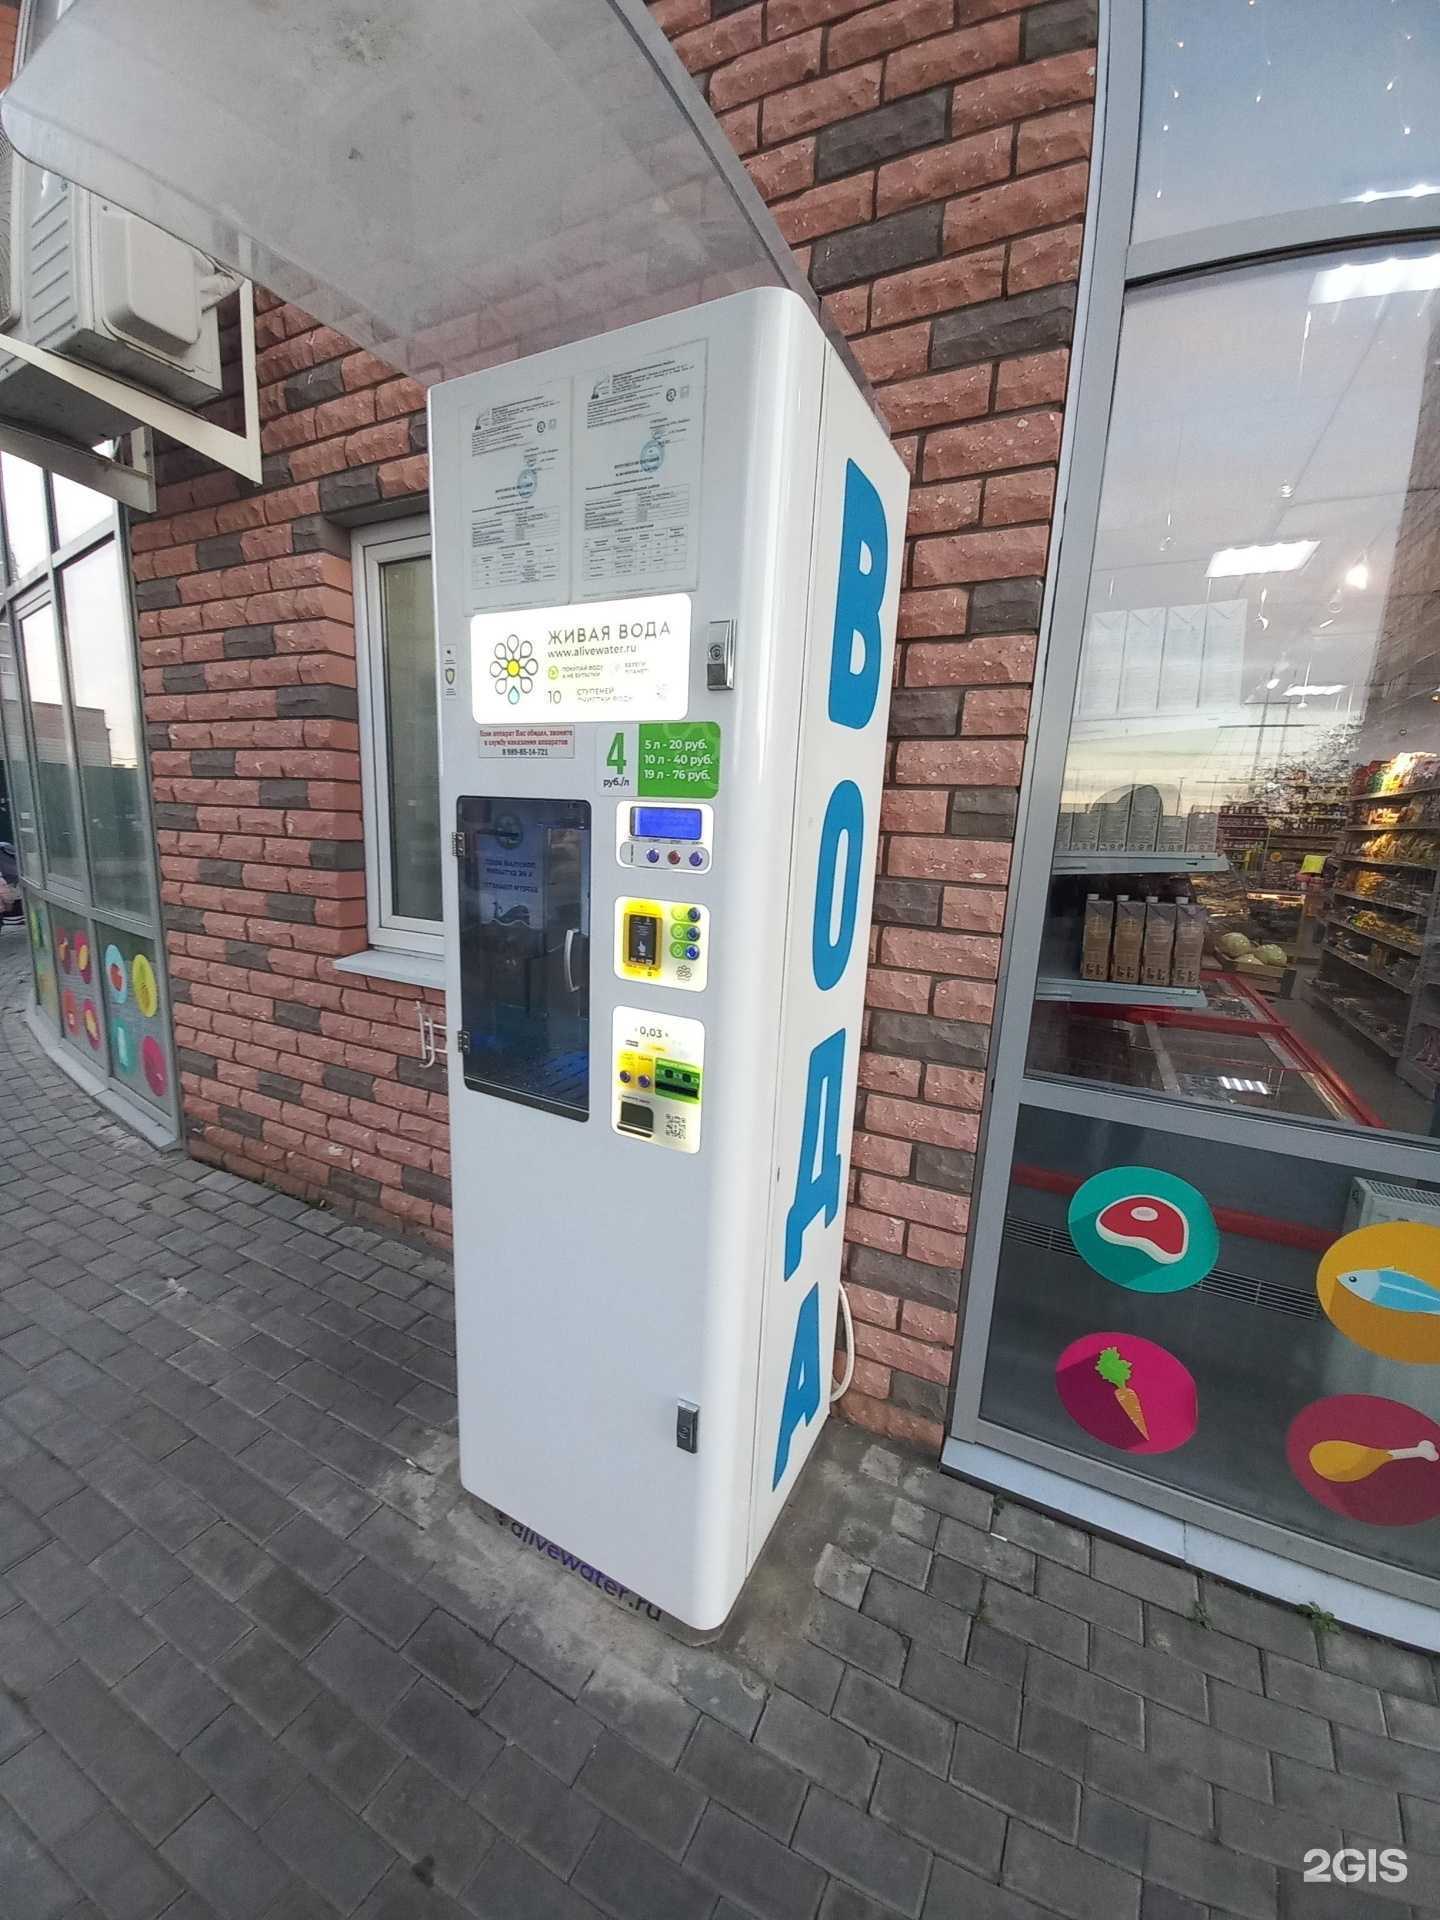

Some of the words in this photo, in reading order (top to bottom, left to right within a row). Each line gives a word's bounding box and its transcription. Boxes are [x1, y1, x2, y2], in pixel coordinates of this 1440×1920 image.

[548, 625, 610, 645] ЖИВАЯ
[619, 621, 671, 640] ВОДА
[547, 644, 637, 658] www.alivewater.ru
[548, 690, 562, 704] 10
[645, 740, 653, 749] 5
[669, 740, 682, 749] 20
[685, 739, 708, 751] руб.
[606, 732, 627, 775] 4
[644, 755, 656, 764] 10
[673, 755, 688, 764] 40
[690, 754, 713, 766] руб.
[644, 770, 655, 779] 19
[672, 770, 685, 779] 76
[687, 769, 710, 781] руб.
[603, 777, 630, 788] руб./л
[773, 457, 888, 1492] ВОДА
[640, 1025, 662, 1039] 0,03
